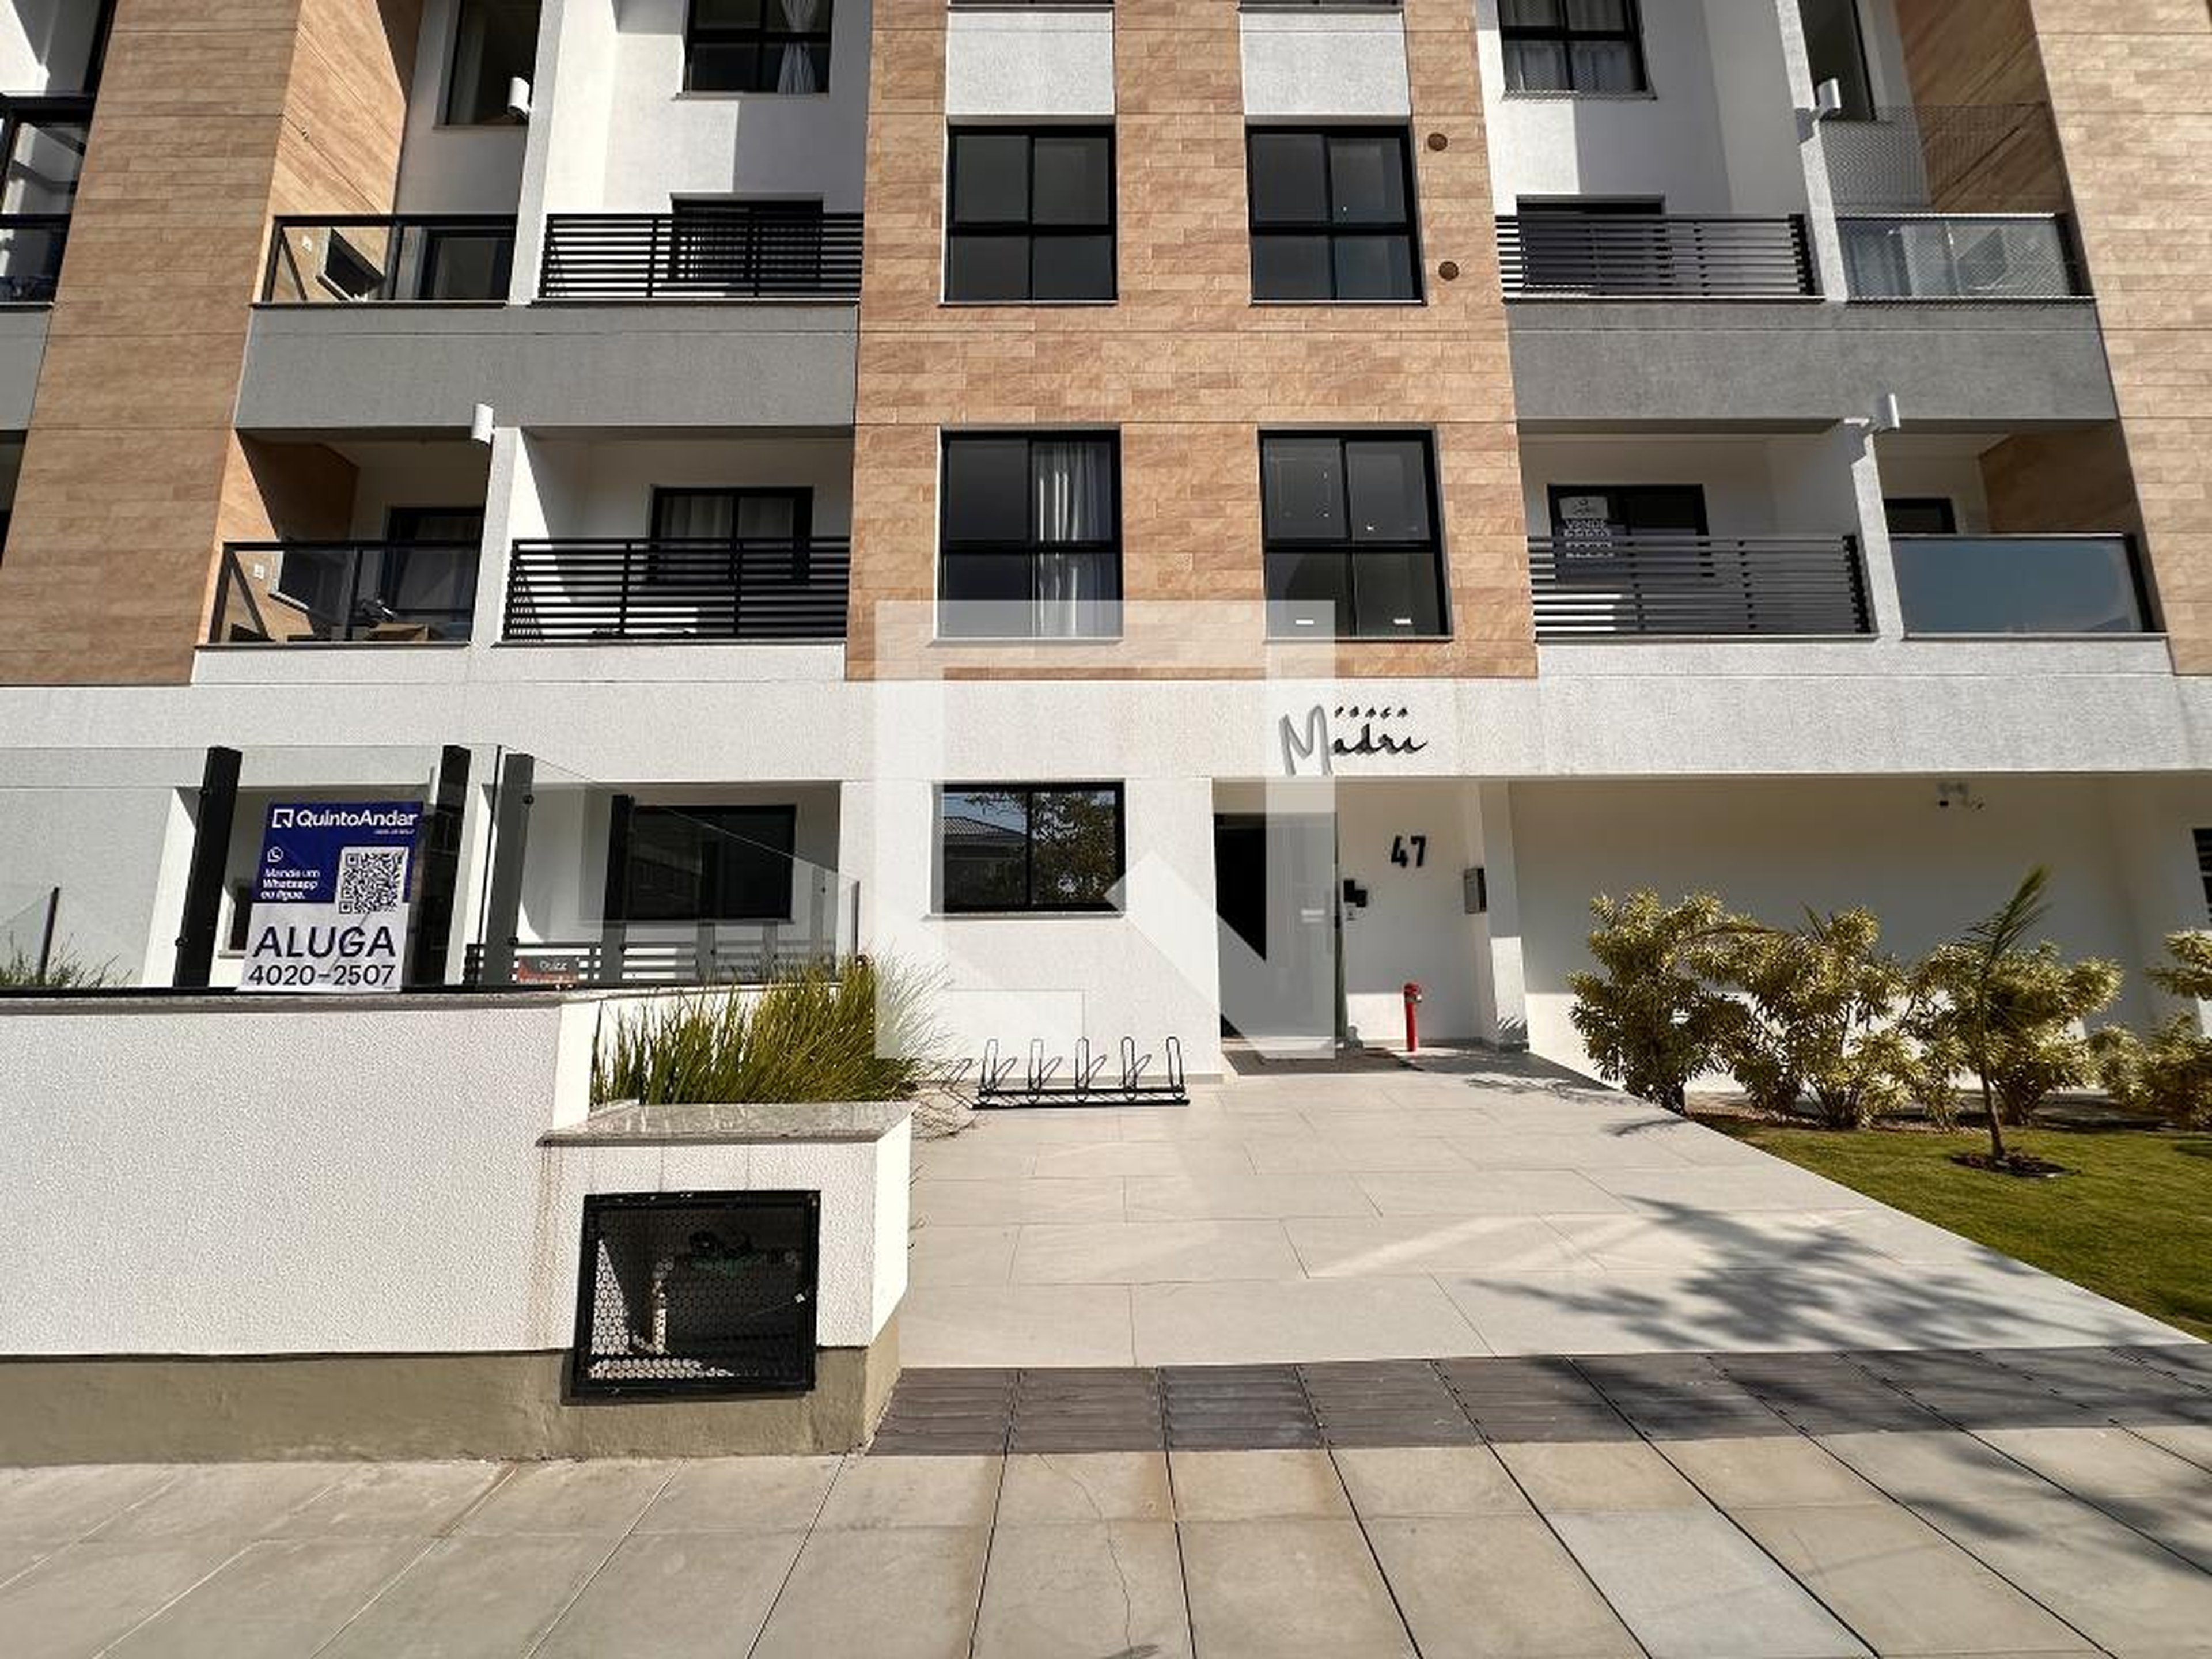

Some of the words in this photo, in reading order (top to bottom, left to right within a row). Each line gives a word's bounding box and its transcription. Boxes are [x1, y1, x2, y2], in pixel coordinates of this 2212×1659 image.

[297, 809, 418, 828] QuintoAndar
[1390, 835, 1426, 868] 47
[252, 926, 396, 957] ALUGA
[248, 965, 396, 986] 4020-2507
